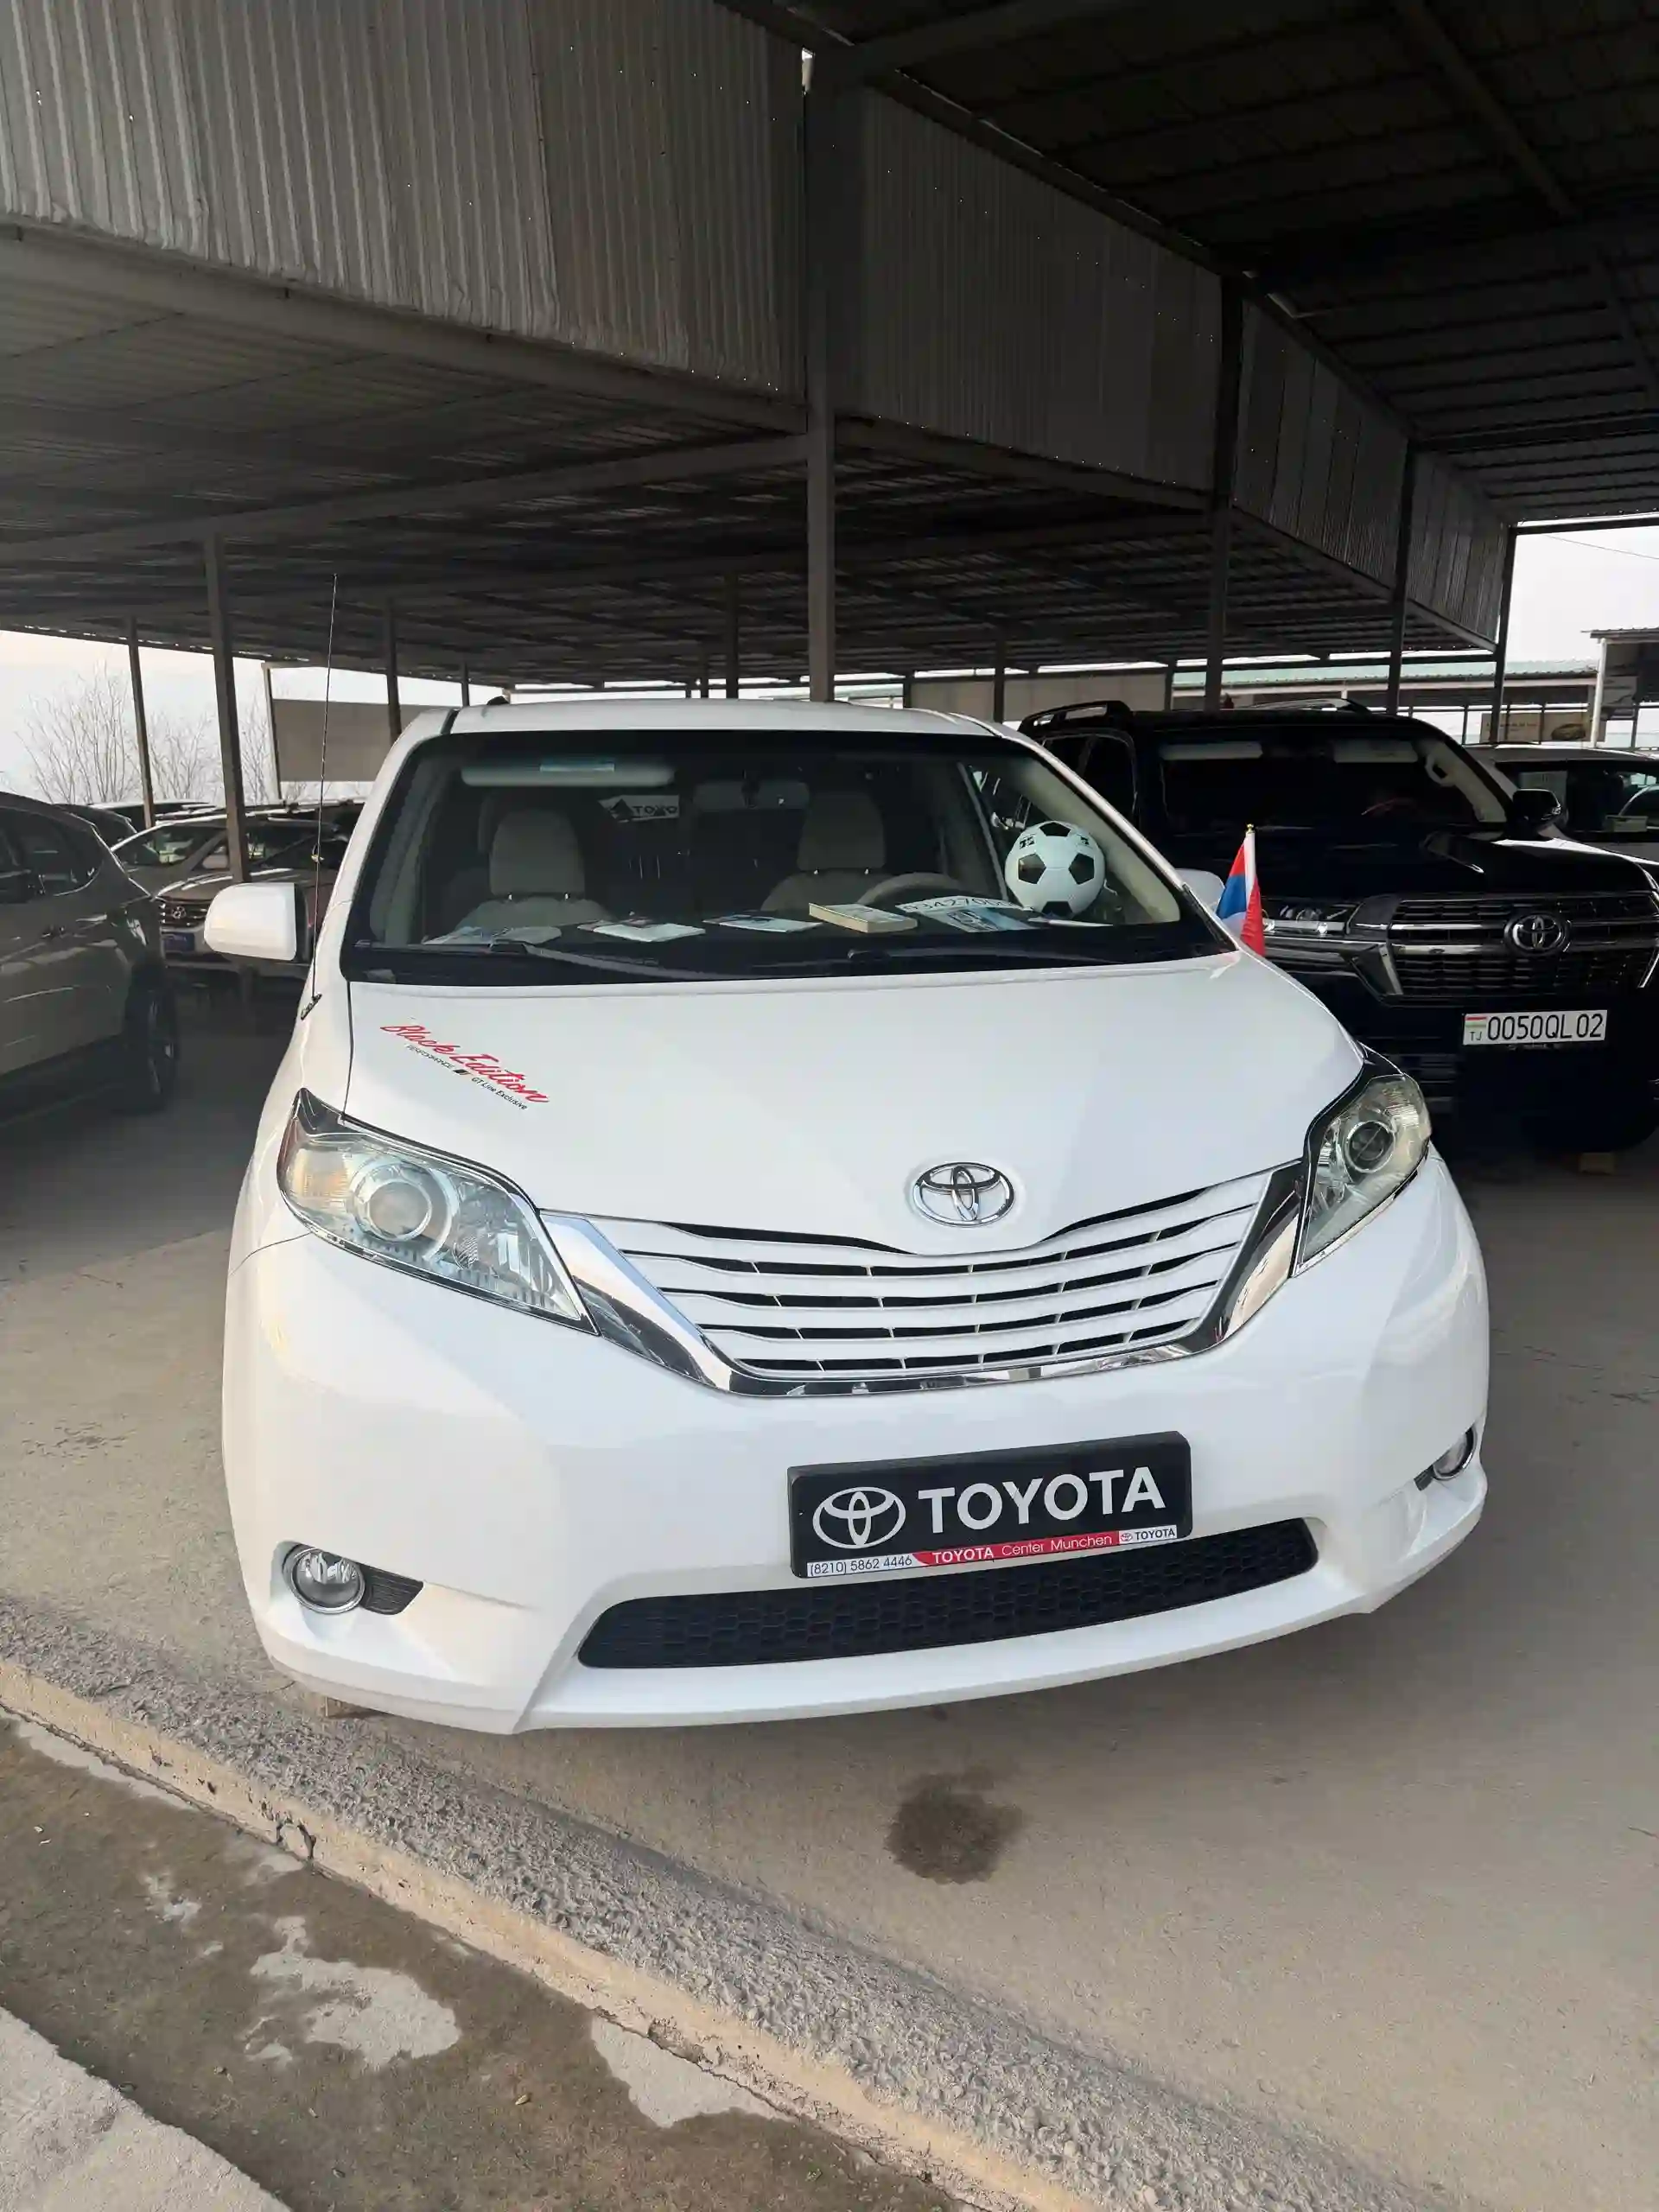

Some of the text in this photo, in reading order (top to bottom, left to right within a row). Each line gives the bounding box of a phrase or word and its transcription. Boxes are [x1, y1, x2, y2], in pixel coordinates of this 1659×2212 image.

[1470, 1031, 1483, 1041] TJ
[1576, 1013, 1604, 1038] 02
[449, 1053, 550, 1103] Edition
[481, 1082, 497, 1092] Line
[496, 1090, 527, 1110] Exclusive
[918, 1465, 1166, 1534] TOYOTA
[810, 1528, 1175, 1576] (8210) 5862 4446 TOYOTA Center Munchen TOYOTA
